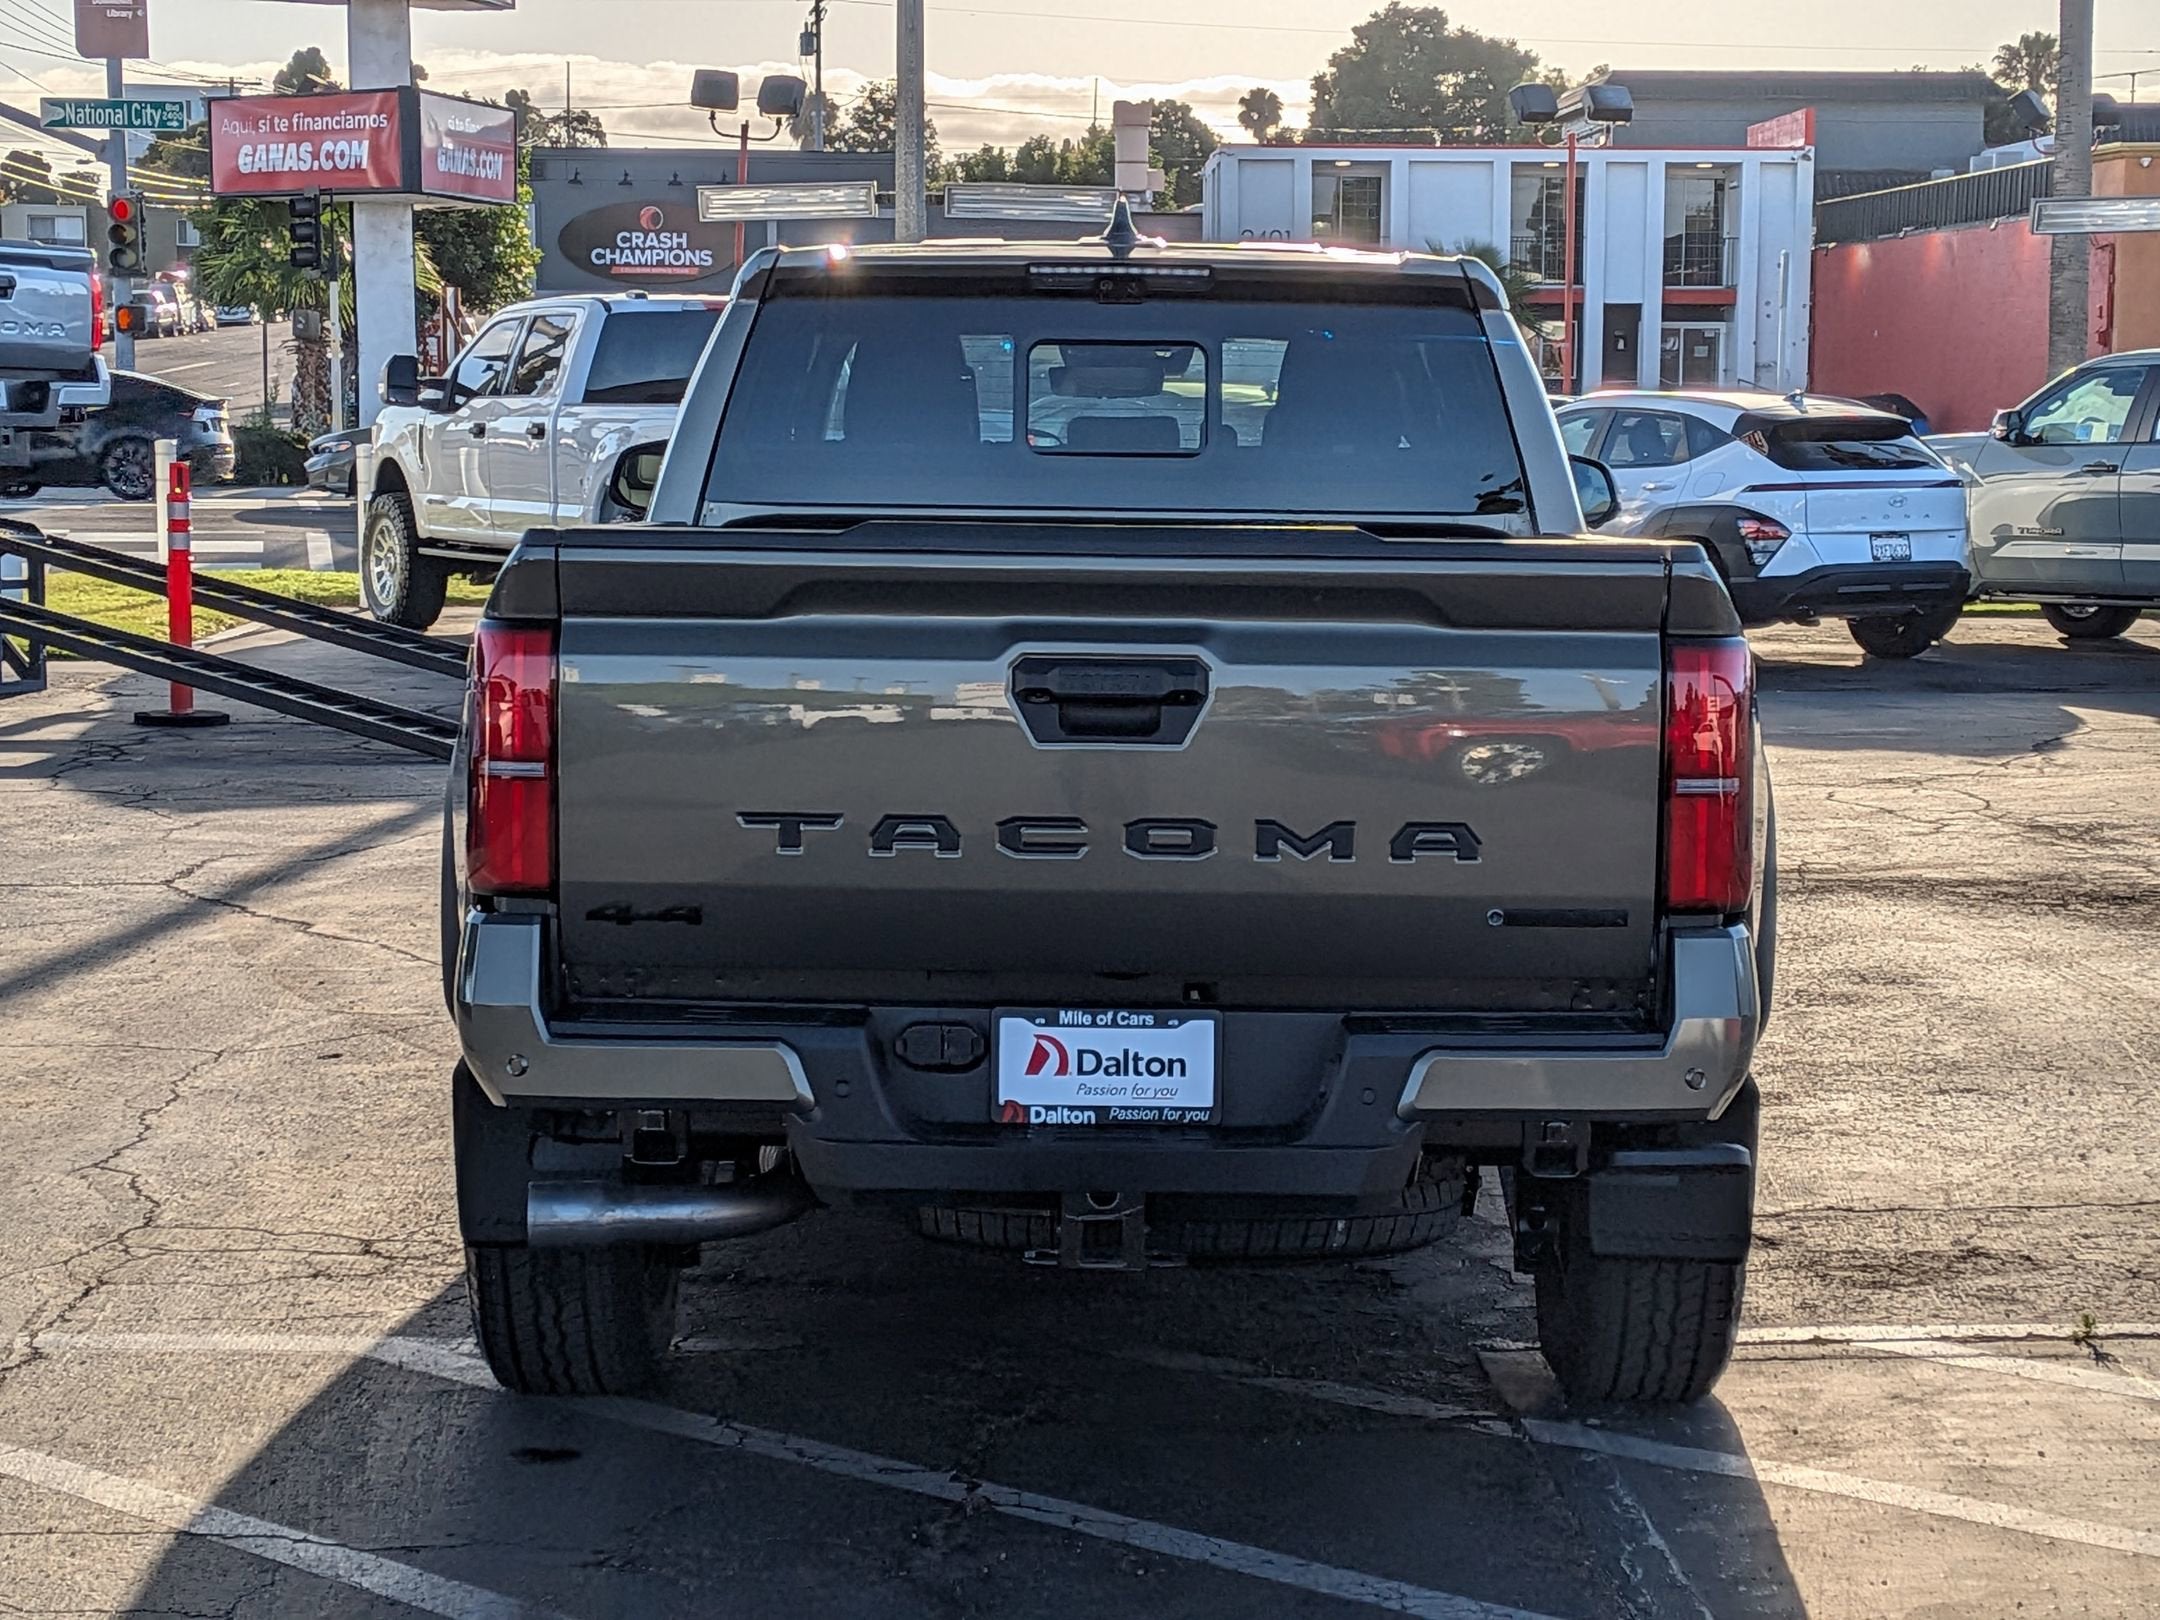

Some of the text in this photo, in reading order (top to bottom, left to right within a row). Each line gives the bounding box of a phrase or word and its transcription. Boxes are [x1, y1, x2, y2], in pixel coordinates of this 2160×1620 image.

[106, 9, 133, 20] Library
[65, 102, 161, 128] National City
[274, 116, 289, 132] te
[292, 110, 388, 132] financiamos
[238, 140, 369, 174] GANAS.COM
[437, 147, 503, 181] GANAS.COM
[616, 231, 687, 249] CRASH
[590, 248, 713, 266] CHAMPIONS
[736, 812, 1482, 863] TACOMA
[1059, 1010, 1155, 1026] Mile of Cars
[1076, 1048, 1186, 1078] Dalton
[1076, 1083, 1179, 1099] Passion for you
[1029, 1106, 1210, 1125] Dalton Passion for you
